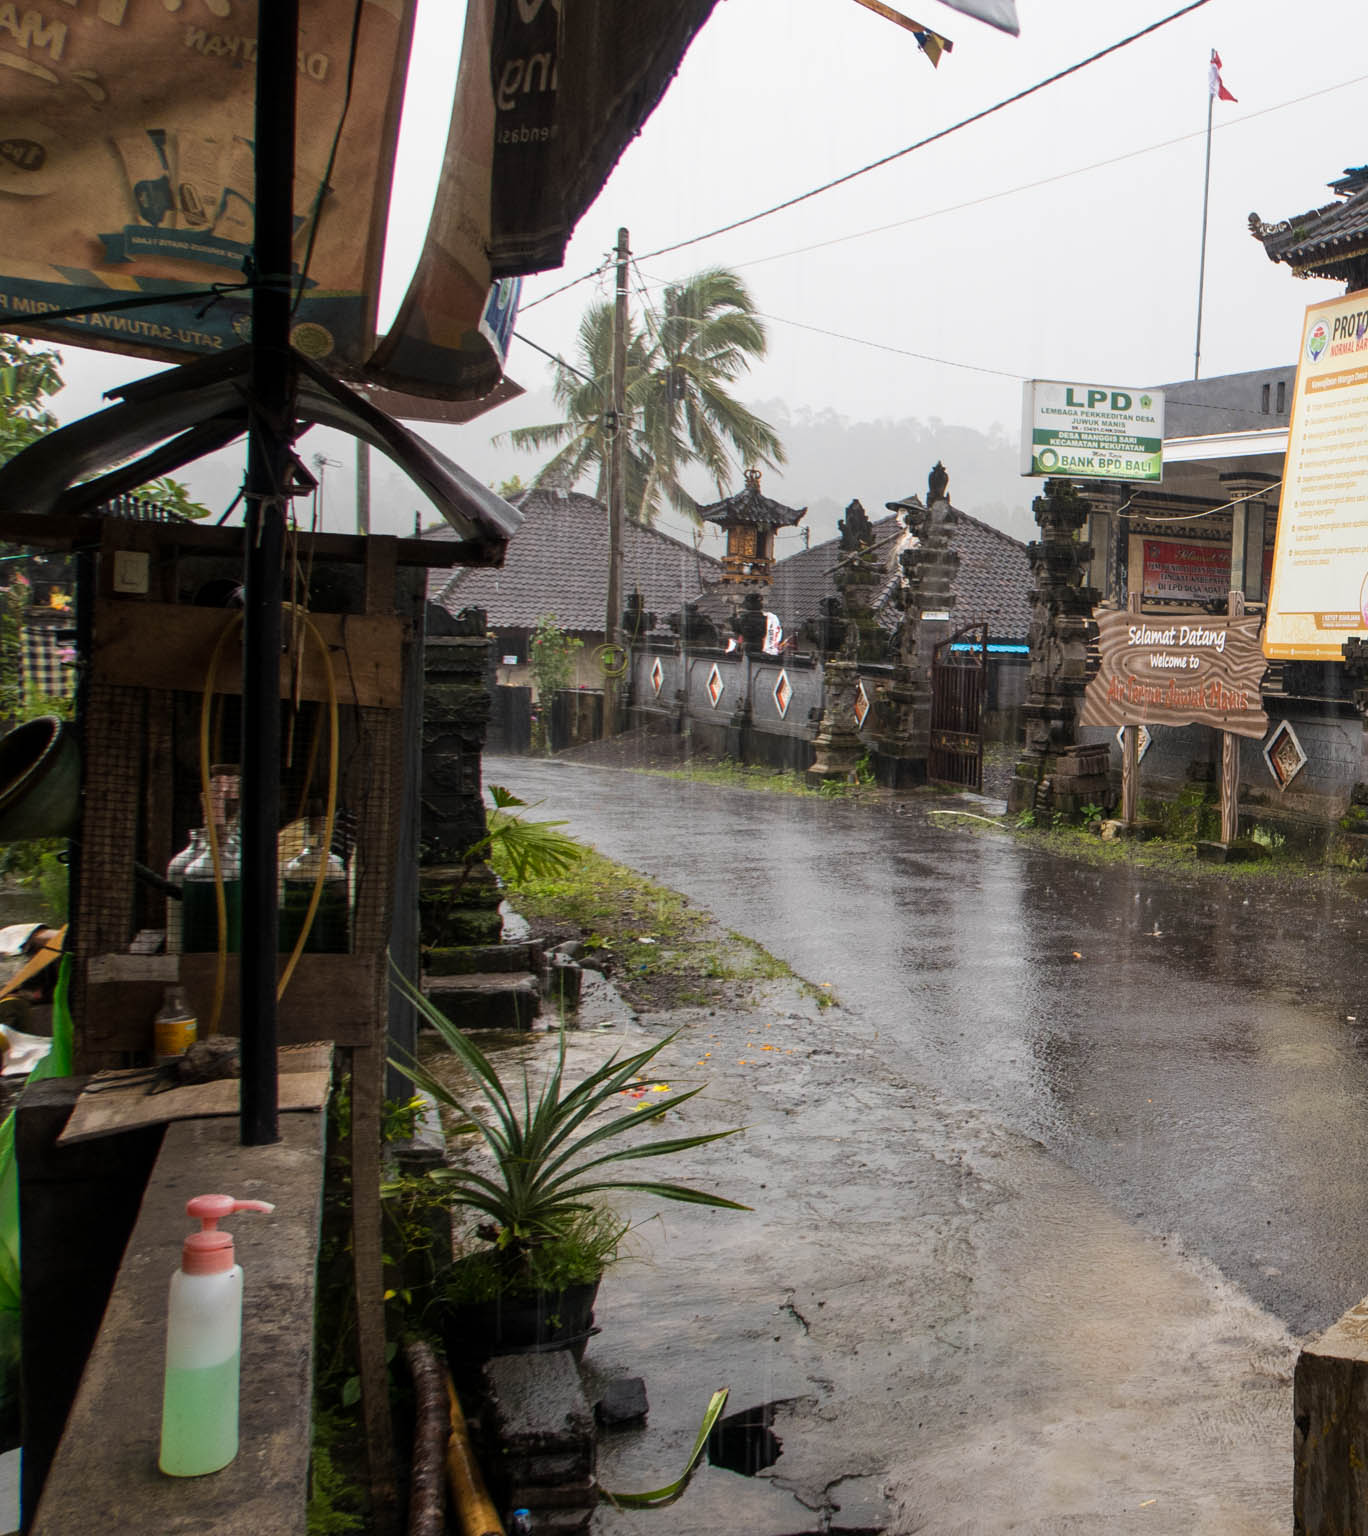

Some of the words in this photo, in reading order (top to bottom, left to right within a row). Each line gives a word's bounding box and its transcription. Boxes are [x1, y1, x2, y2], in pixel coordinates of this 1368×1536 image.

[1066, 387, 1132, 411] LPD
[1040, 407, 1079, 417] LEMBAGA
[1080, 410, 1134, 421] PERKREDITAN
[1135, 415, 1156, 423] DESA
[1071, 418, 1100, 426] JUWUK
[1101, 420, 1126, 428] MANIS
[1049, 438, 1098, 449] KECAMATAN
[1099, 442, 1145, 452] PEKUTATAN
[1058, 431, 1080, 440] DESA
[1080, 432, 1118, 443] MANGGIS
[1119, 436, 1137, 444] SARI
[1061, 455, 1095, 468] BANK
[1098, 458, 1122, 469] BPD
[1125, 460, 1152, 473] BALI
[1127, 623, 1177, 646] Selamat
[1179, 626, 1227, 653] Datang
[1150, 652, 1187, 669] Welcome
[1189, 655, 1200, 669] to
[1106, 675, 1126, 704] Air
